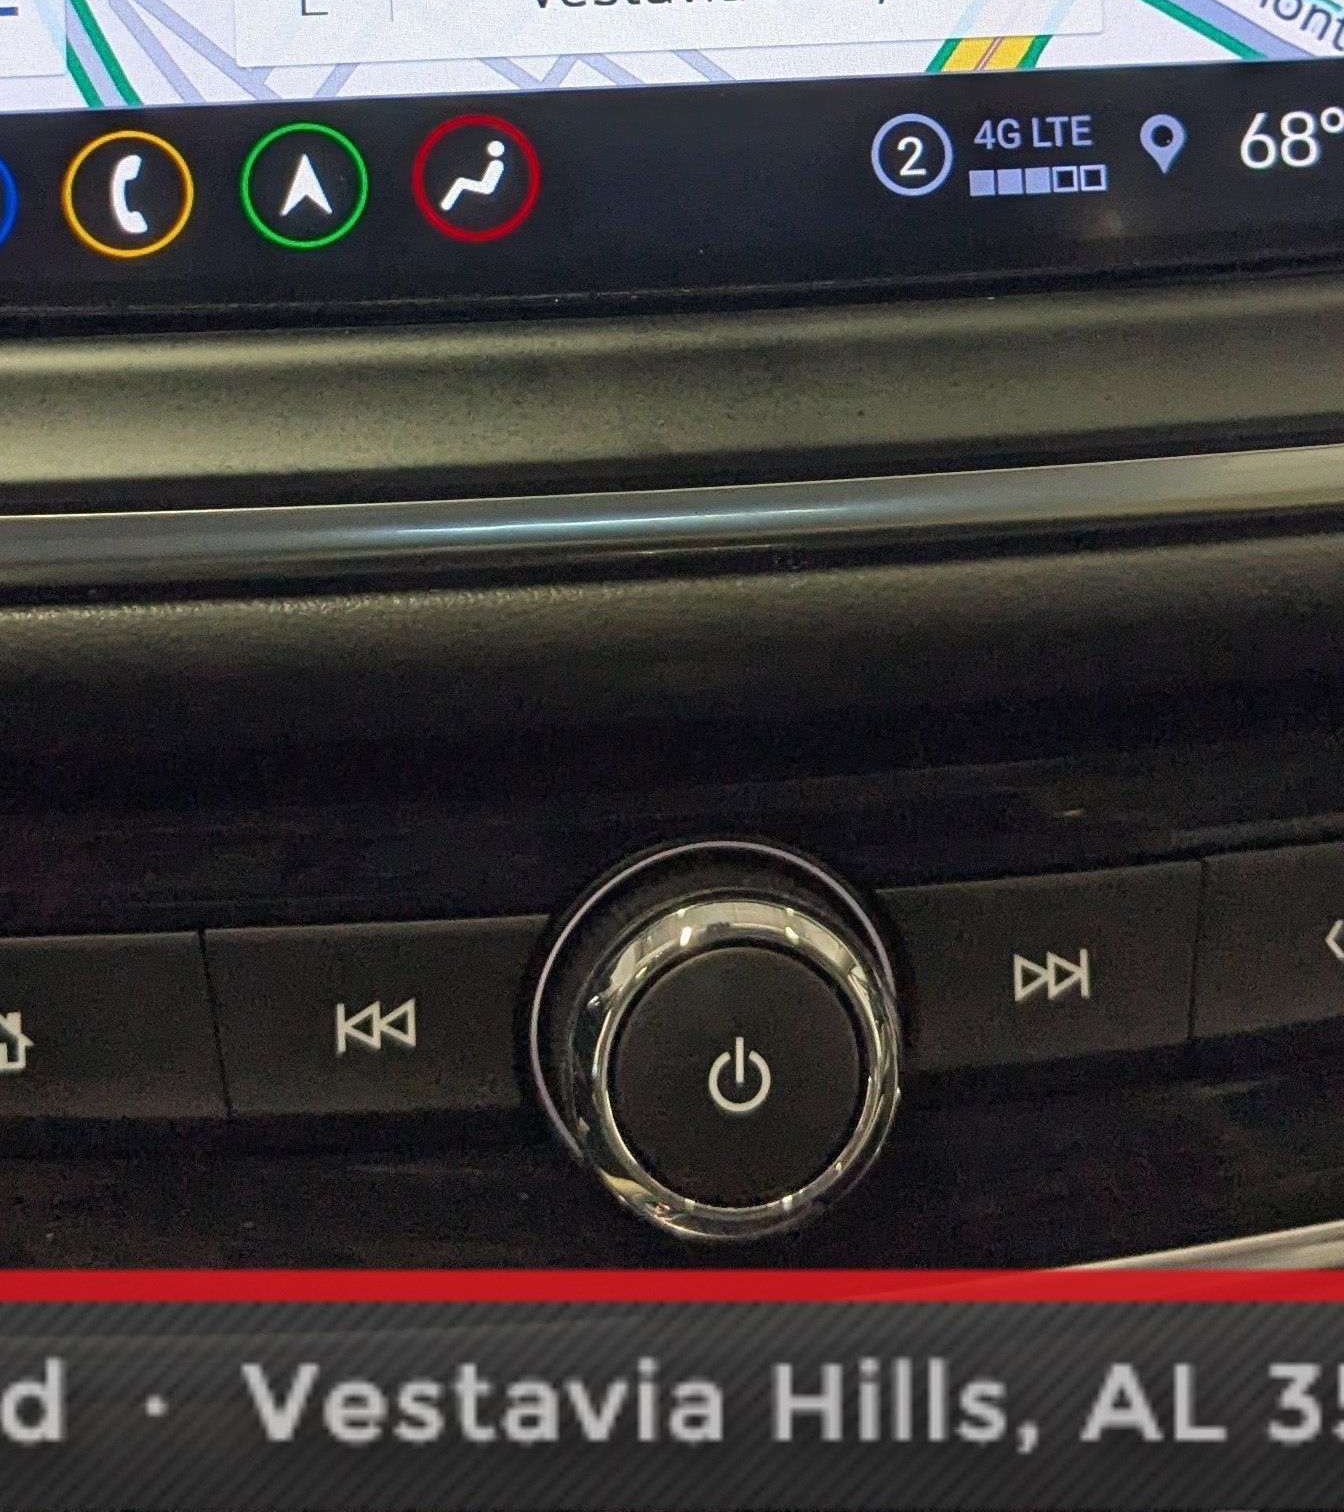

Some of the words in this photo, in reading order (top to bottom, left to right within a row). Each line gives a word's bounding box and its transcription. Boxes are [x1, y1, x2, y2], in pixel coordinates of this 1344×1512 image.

[973, 117, 1023, 150] 4G
[1031, 114, 1094, 148] LTE
[895, 135, 928, 178] 2
